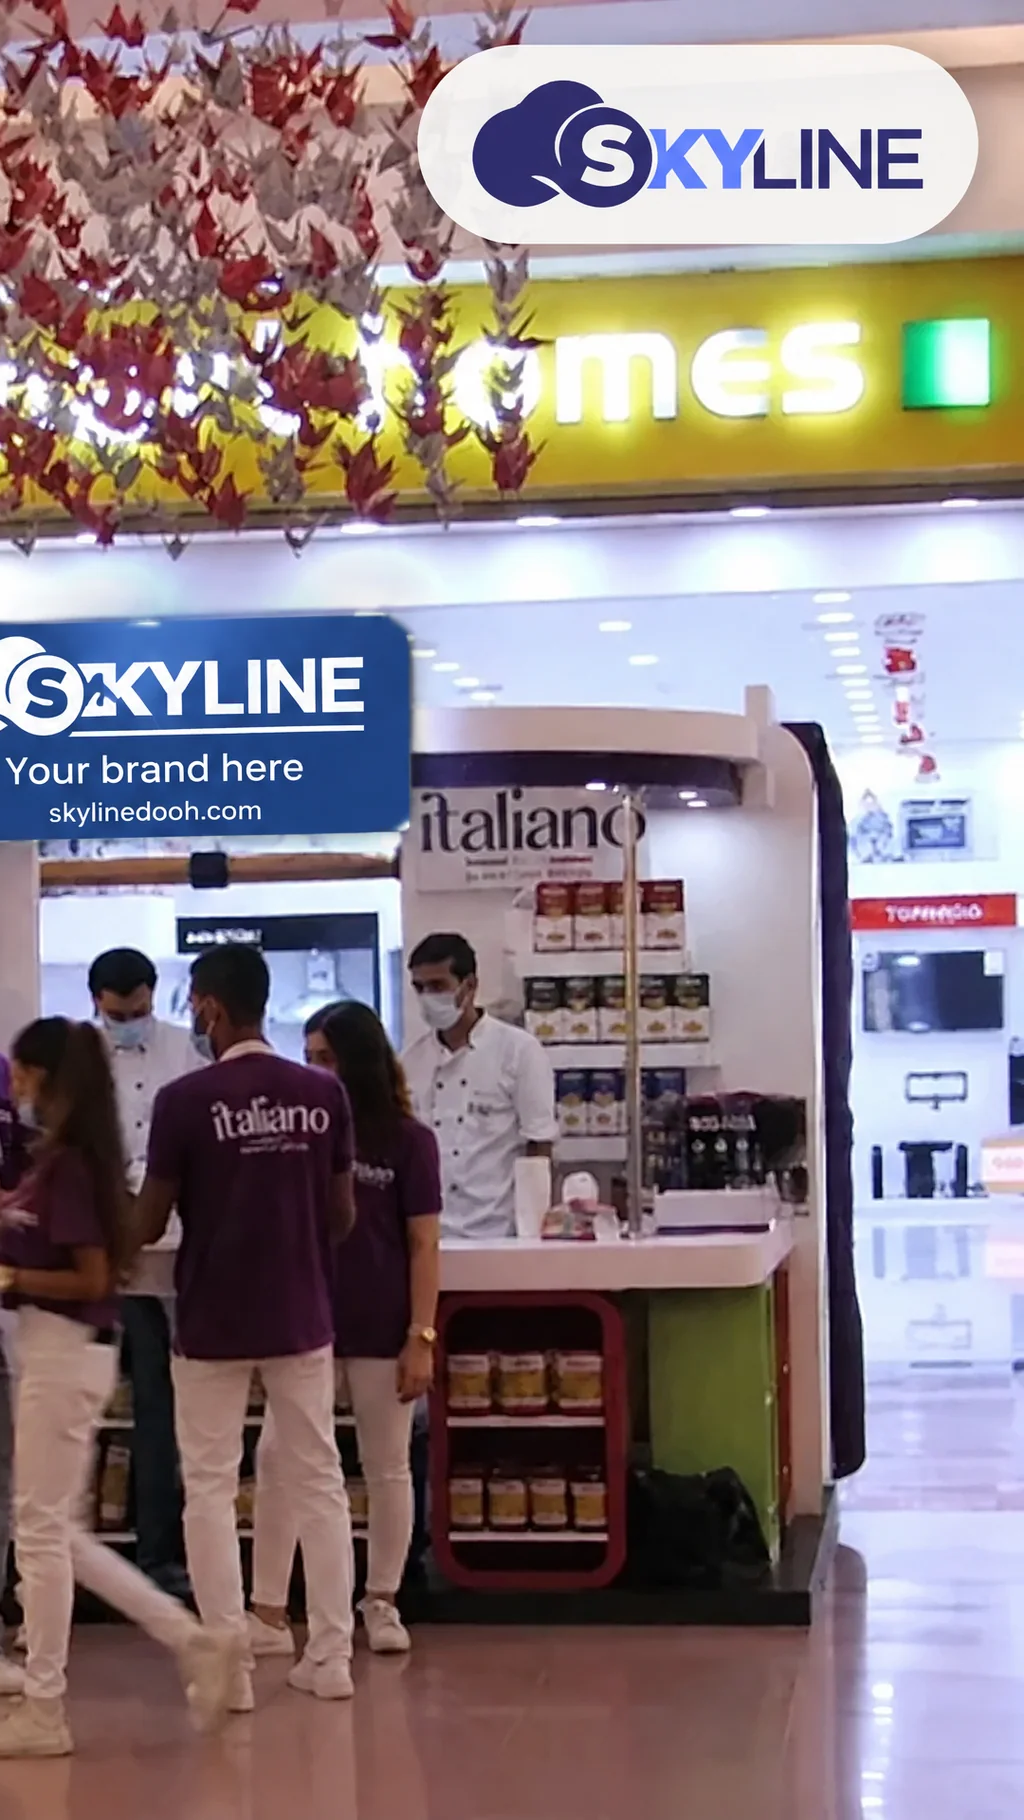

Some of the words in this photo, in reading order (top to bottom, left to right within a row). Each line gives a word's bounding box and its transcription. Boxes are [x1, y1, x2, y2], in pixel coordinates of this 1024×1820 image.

[5, 754, 90, 786] Your
[101, 753, 210, 784] brand
[222, 753, 305, 783] here
[48, 802, 263, 828] skylinedooh.com
[420, 787, 647, 854] italiano
[210, 1095, 331, 1142] italiano
